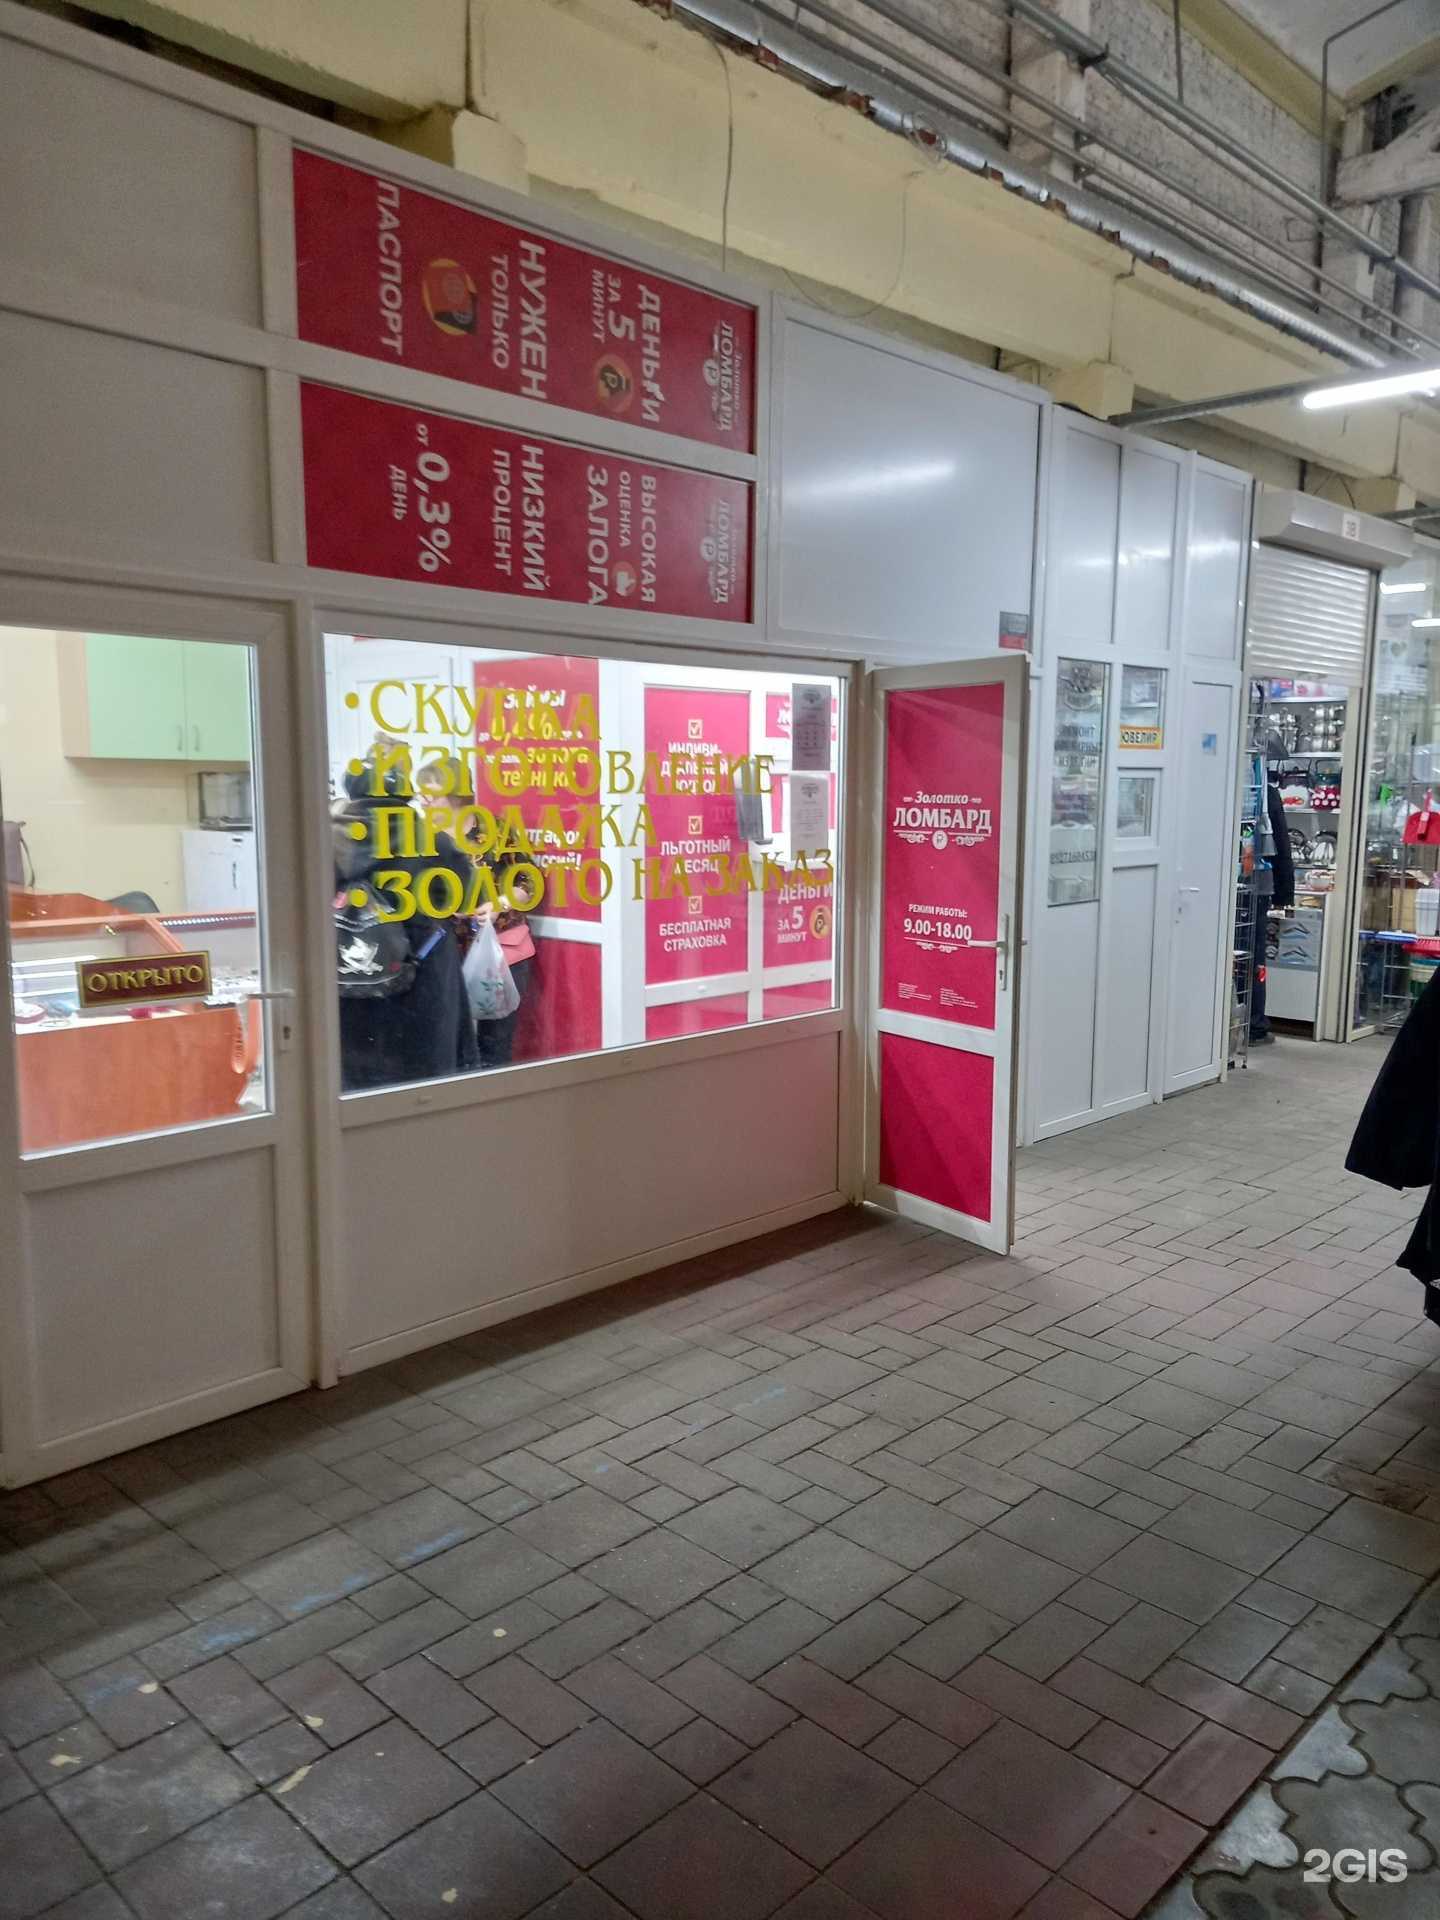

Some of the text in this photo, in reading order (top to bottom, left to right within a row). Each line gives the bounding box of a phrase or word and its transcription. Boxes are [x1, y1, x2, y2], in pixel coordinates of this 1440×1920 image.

[376, 180, 402, 355] ПАСПОРТ
[491, 254, 509, 369] ТОЛЬКО
[519, 239, 547, 399] НУЖЕН
[592, 269, 605, 343] МИНУТ
[608, 274, 635, 341] ЗА 5
[717, 321, 733, 431] ЛОМБАРД
[388, 464, 408, 521] ДЕНЬ
[413, 452, 452, 573] 0,3%
[492, 449, 512, 576] ПРОЦЕНТ
[521, 444, 551, 591] НИЗКИЙ
[617, 471, 631, 547] ОЦЕНКА
[587, 464, 609, 605] ЗАЛОГА
[641, 475, 656, 603] ВЫСОКАЯ
[715, 500, 729, 604] ЛОМБАРД
[370, 680, 602, 740] СКУПКА
[370, 803, 658, 861] ПРОДАЖА
[893, 807, 992, 834] ЛОМБАРД
[915, 791, 969, 804] Золотко
[660, 836, 731, 856] ЛЬГОТНЫЙ
[374, 848, 834, 924] ЗОЛОТО НА ЗАКАЗ
[791, 905, 805, 930] 5
[909, 904, 934, 915] РЕЖИМ
[659, 917, 731, 937] БЕСПЛАТНАЯ
[664, 934, 727, 952] СТРАХОВКА
[904, 918, 972, 941] 9.00-18.00
[88, 965, 203, 992] ОТКРЫТО
